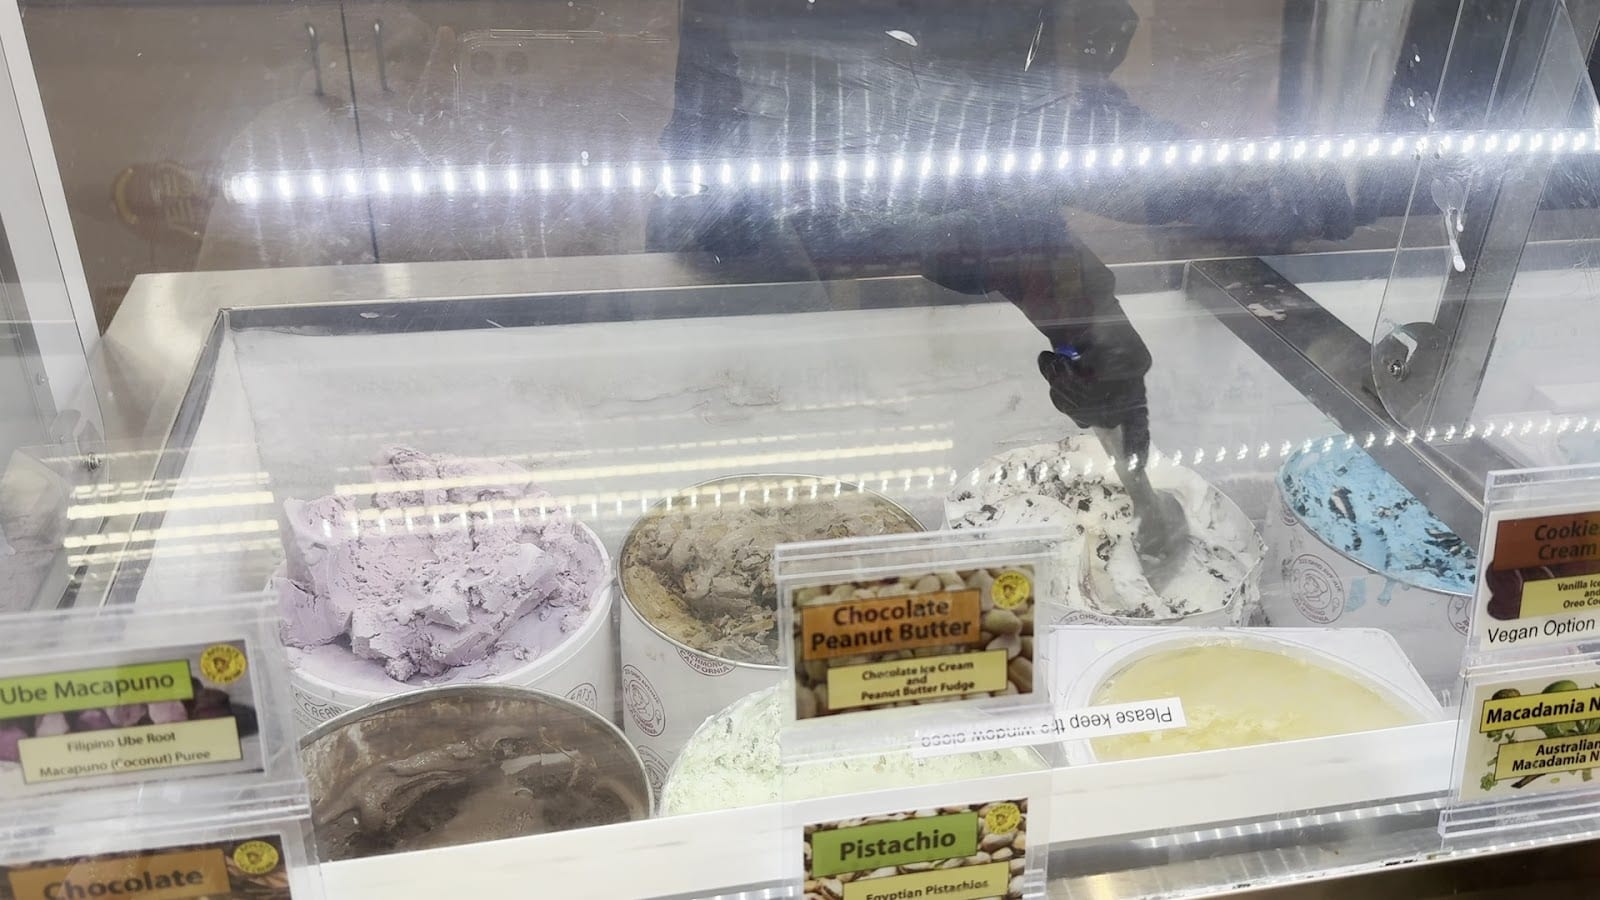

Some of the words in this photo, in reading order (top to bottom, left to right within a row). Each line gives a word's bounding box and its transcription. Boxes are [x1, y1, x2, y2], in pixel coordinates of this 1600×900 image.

[1535, 520, 1600, 541] Cookie
[1538, 543, 1597, 560] Cream
[1557, 580, 1588, 591] Vanilla
[833, 598, 950, 627] Chocolate
[1563, 599, 1585, 609] Oreo
[811, 626, 893, 651] Peanut
[900, 619, 972, 641] Butter
[1487, 623, 1538, 645] Vegan
[1544, 617, 1596, 637] Option
[862, 666, 917, 681] Chocolate
[920, 665, 936, 675] Ice
[938, 660, 974, 673] Cream
[906, 674, 928, 685] and
[0, 683, 48, 706] Ube
[54, 673, 175, 699] Macapuno
[861, 688, 901, 701] Peanut
[903, 685, 938, 698] Butter
[941, 680, 975, 693] Fudge
[1070, 711, 1111, 731] keep
[1116, 705, 1173, 724] Please
[1486, 698, 1585, 724] Macadamia
[67, 738, 115, 753] Filipino
[117, 735, 144, 748] Ube
[147, 731, 176, 745] Root
[1535, 739, 1600, 756] Australian
[39, 761, 108, 778] Macapuno
[110, 753, 173, 771] (Coconut)
[175, 749, 211, 763] Puree
[1511, 752, 1586, 772] Macadamia
[840, 829, 957, 861] Pistachio
[43, 869, 204, 900] Chocolate
[926, 880, 989, 895] Pistachios
